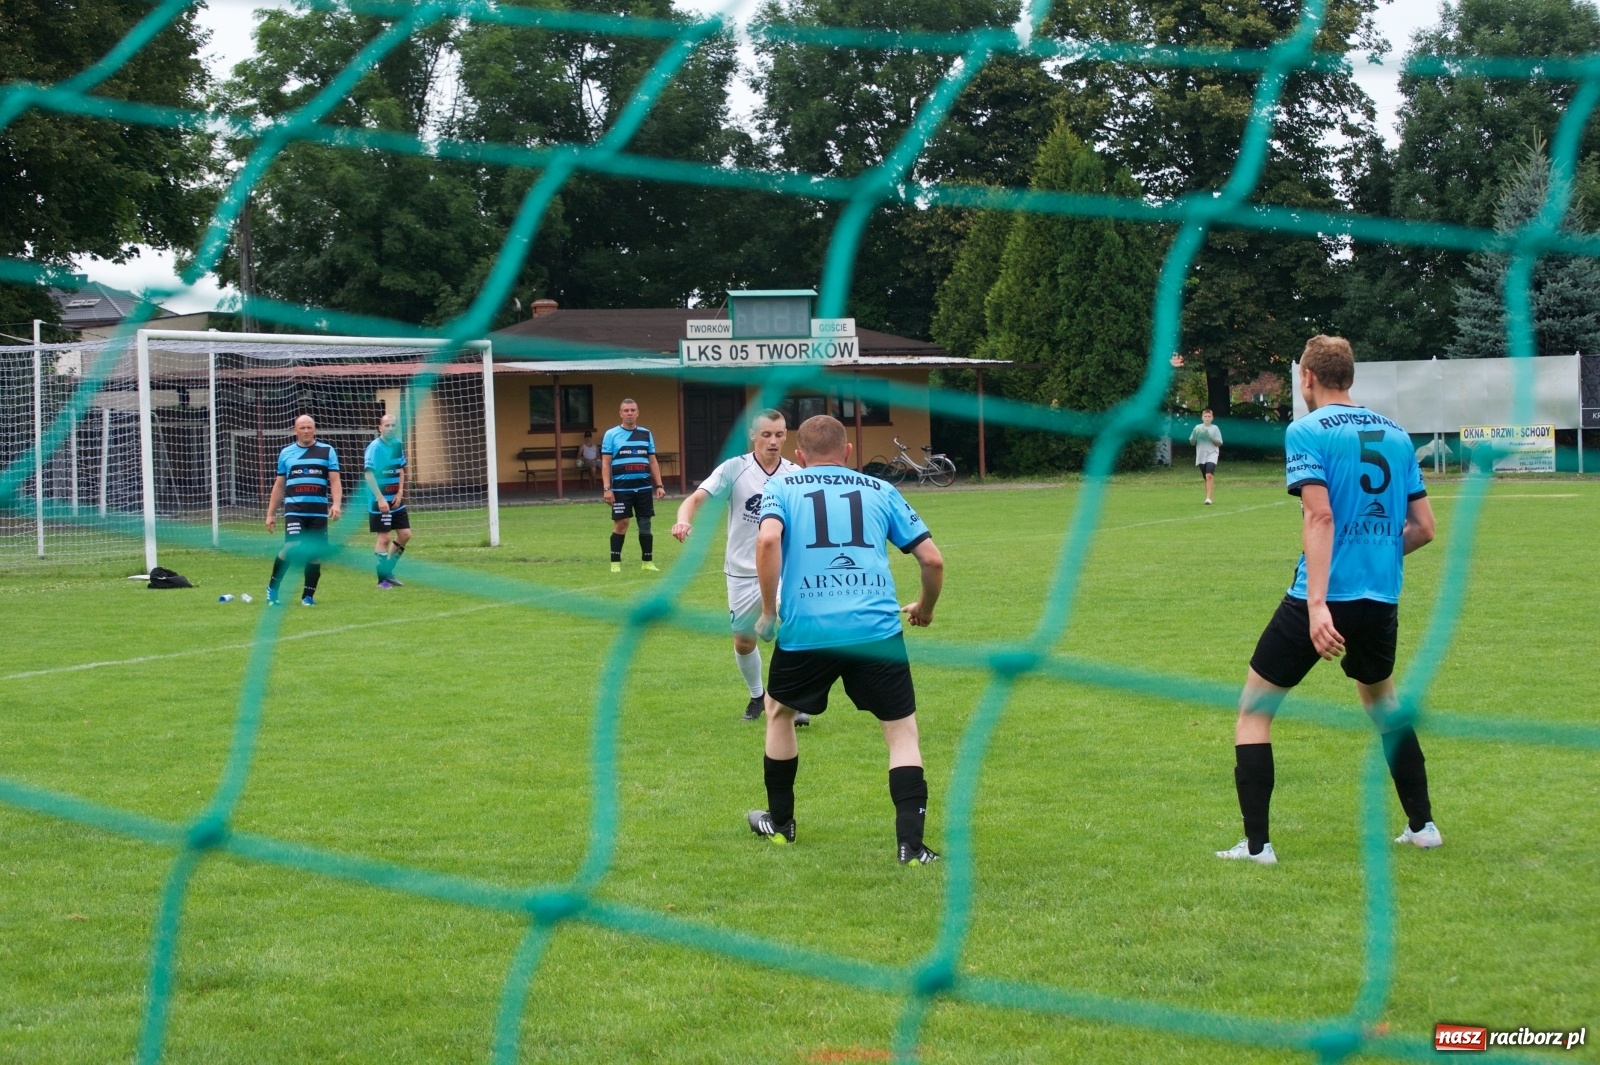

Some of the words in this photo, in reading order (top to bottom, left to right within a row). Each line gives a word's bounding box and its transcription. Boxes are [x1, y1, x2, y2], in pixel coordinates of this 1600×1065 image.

[689, 322, 730, 333] TWORKÓW
[818, 322, 848, 333] GOŚCIE
[687, 345, 722, 361] LKS
[729, 345, 749, 361] 05
[756, 339, 855, 360] TWORKÓW
[1463, 428, 1485, 439] OKNA
[1491, 427, 1514, 438] DRZWI
[1520, 426, 1551, 437] SCHODY
[1357, 430, 1391, 495] 5
[784, 474, 881, 491] RUDYSZWAŁD
[803, 489, 875, 549] 11
[1338, 521, 1404, 537] ARNOLD
[799, 573, 886, 589] ARNOLD
[829, 589, 886, 597] GOŚCINNY
